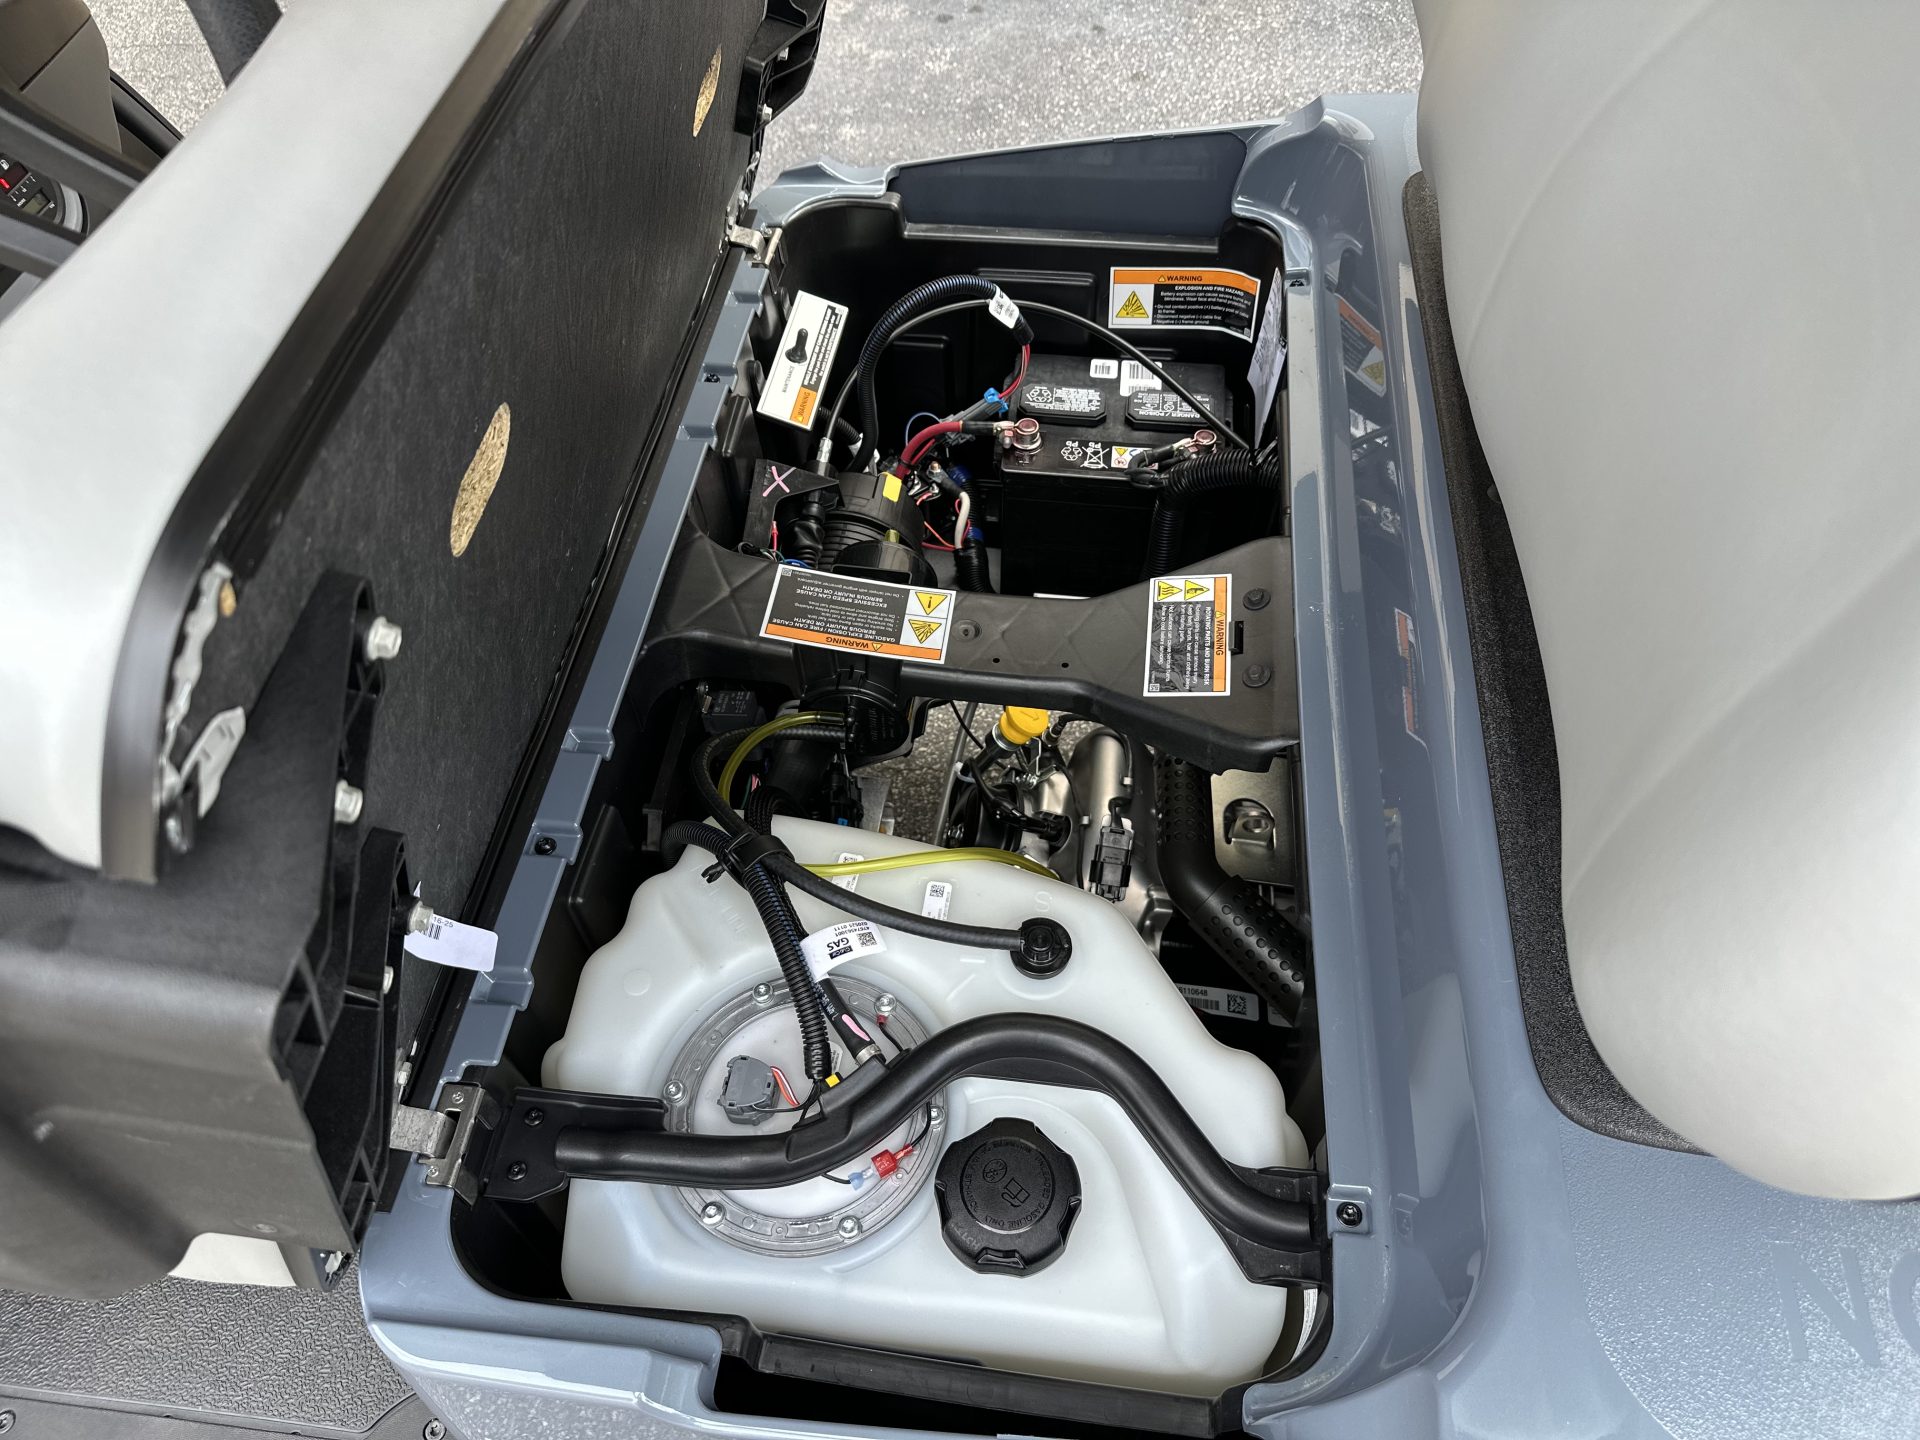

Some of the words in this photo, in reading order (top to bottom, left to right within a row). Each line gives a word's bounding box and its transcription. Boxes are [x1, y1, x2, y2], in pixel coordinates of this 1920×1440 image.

[796, 390, 810, 416] WARNING
[795, 588, 817, 596] CAUSE
[801, 584, 823, 592] DEATH
[855, 593, 883, 602] SERIOUS
[853, 598, 887, 608] EXCESSIVE
[771, 617, 794, 625] CAUSE
[827, 627, 863, 637] EXPLOSION
[848, 626, 876, 634] SERIOUS
[824, 635, 869, 648] WARNING
[863, 633, 896, 642] GASOLINE
[1215, 619, 1224, 655] WARNING
[827, 937, 849, 951] GAS
[1764, 1240, 1920, 1367] N
